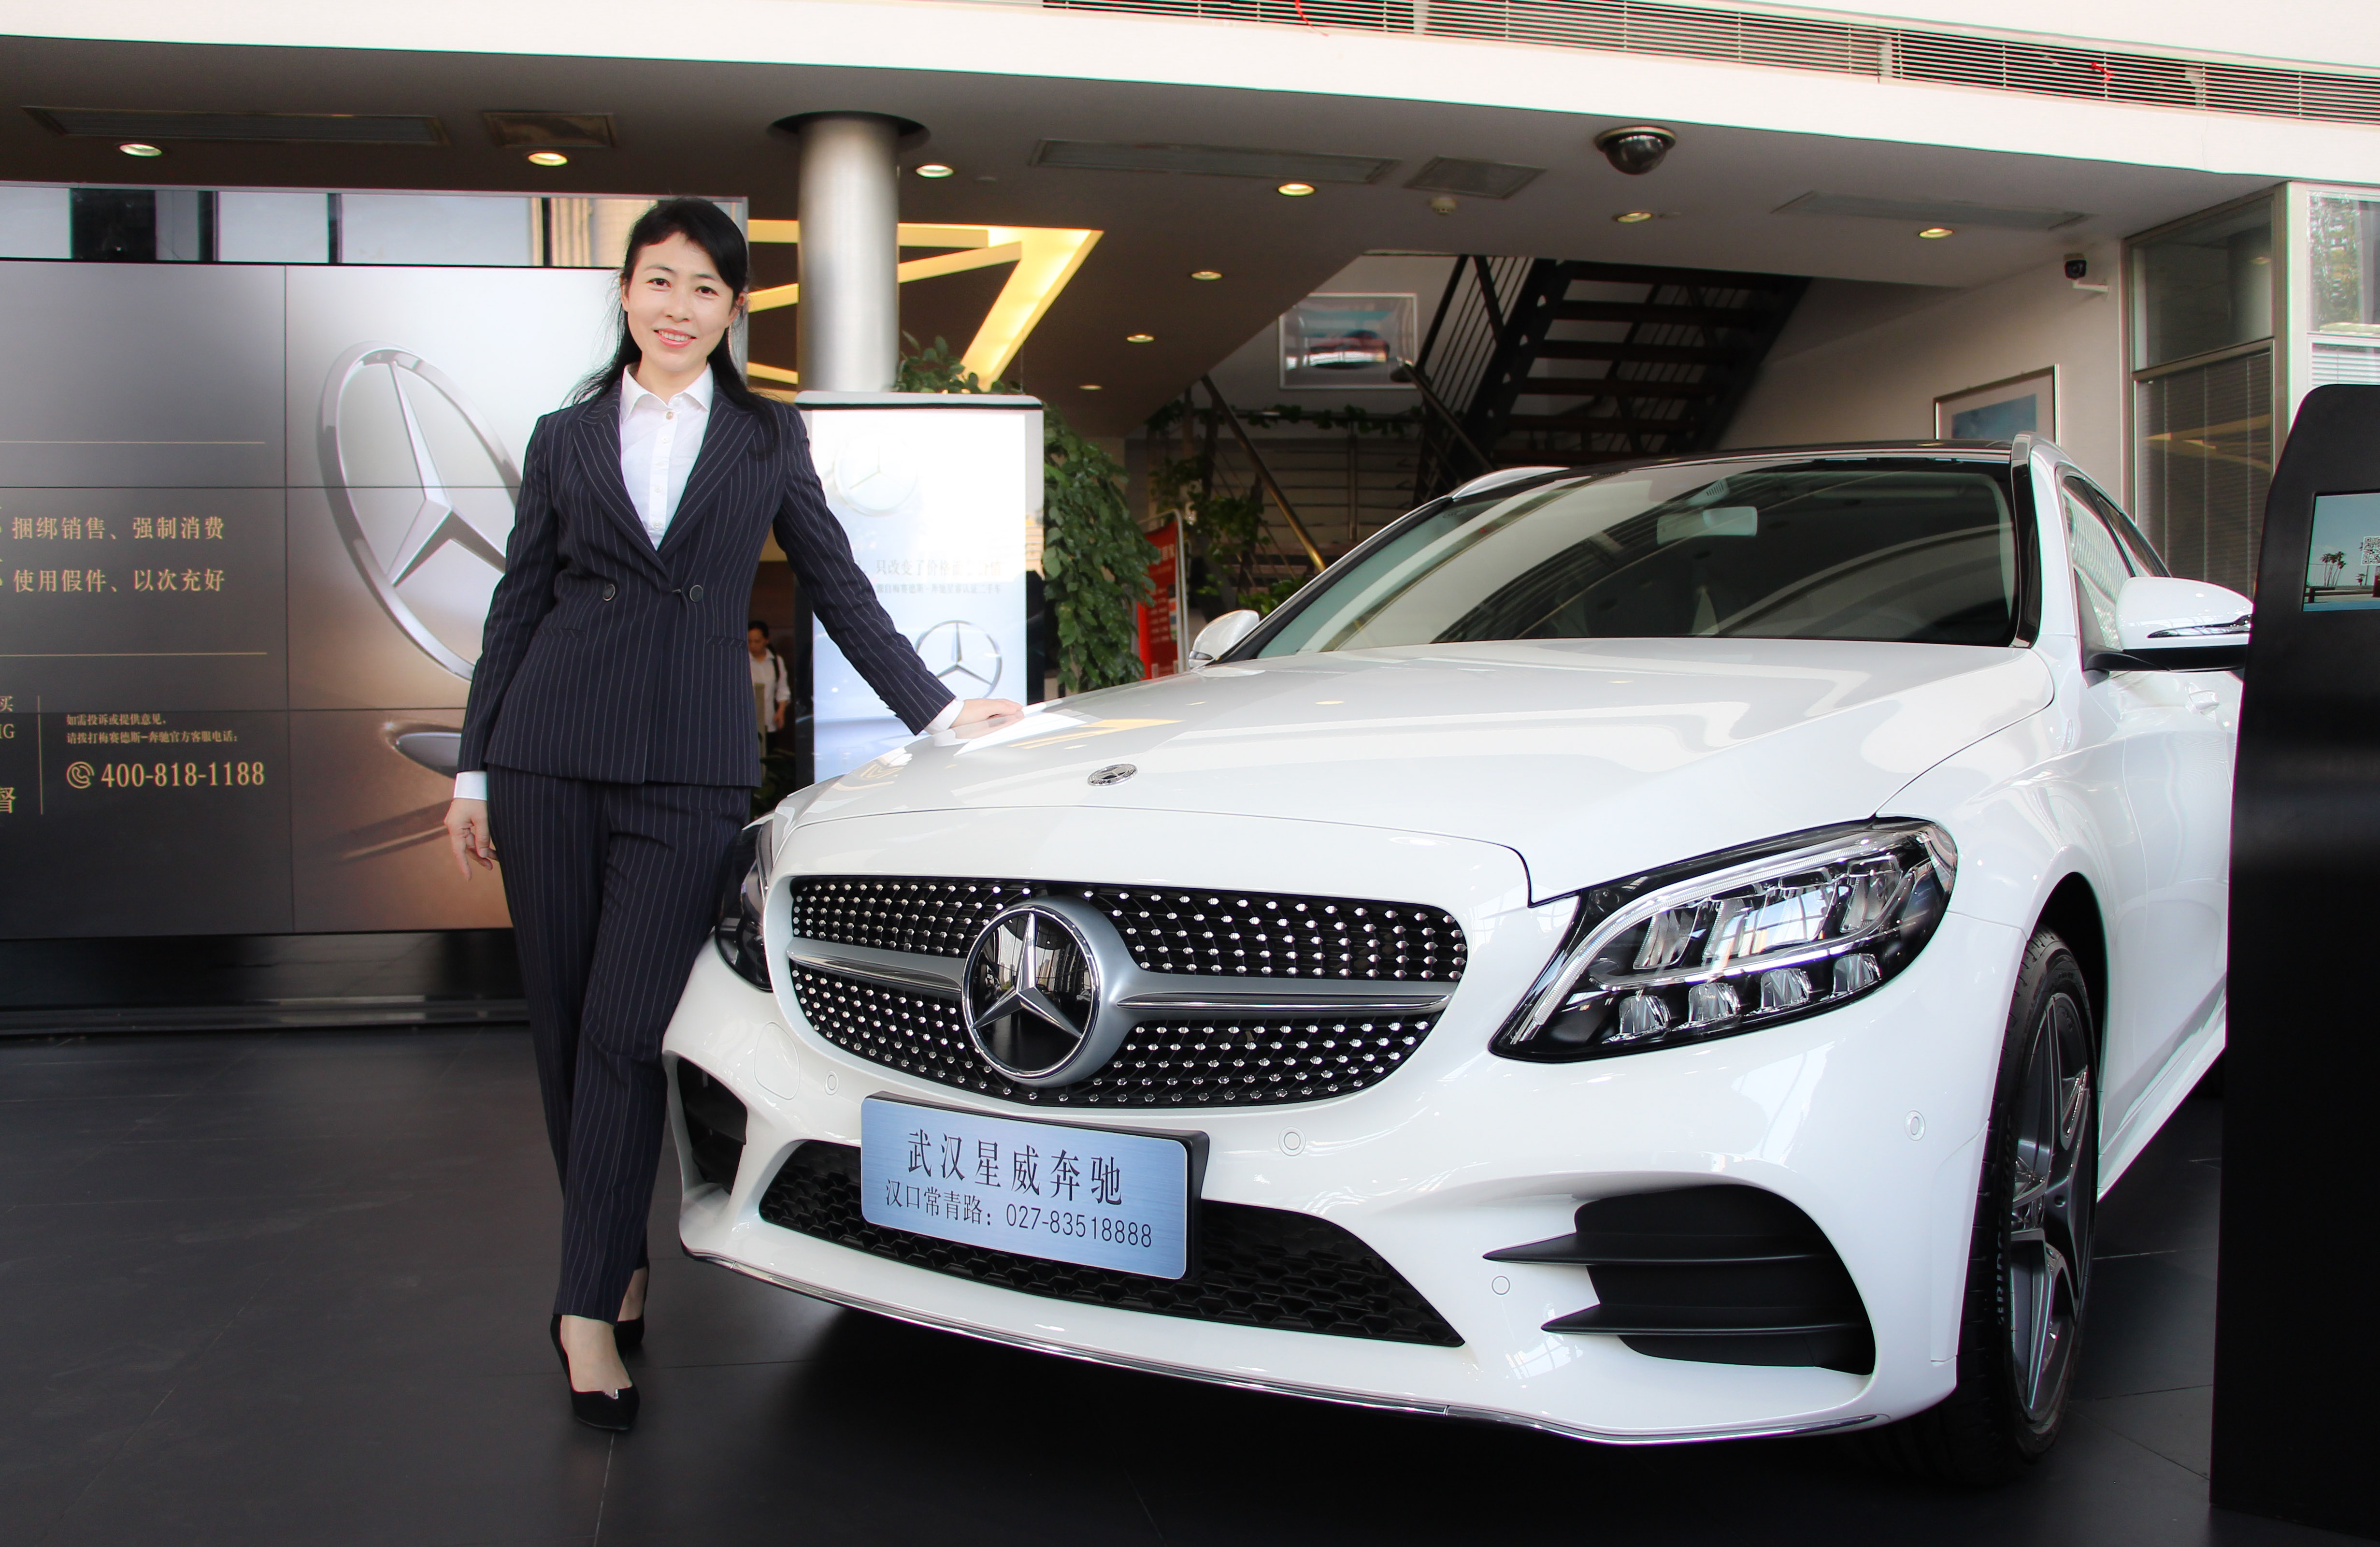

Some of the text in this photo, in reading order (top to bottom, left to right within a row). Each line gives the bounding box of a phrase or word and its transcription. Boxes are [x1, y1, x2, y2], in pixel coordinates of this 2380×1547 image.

[12, 517, 224, 540] 捆绑销售、强制消费
[876, 559, 1001, 577] 只改变了价格而价值
[13, 569, 225, 593] 使用假件、以次充好
[100, 761, 265, 788] 400-818-1188
[907, 1128, 1123, 1205] 武汉星威奔驰
